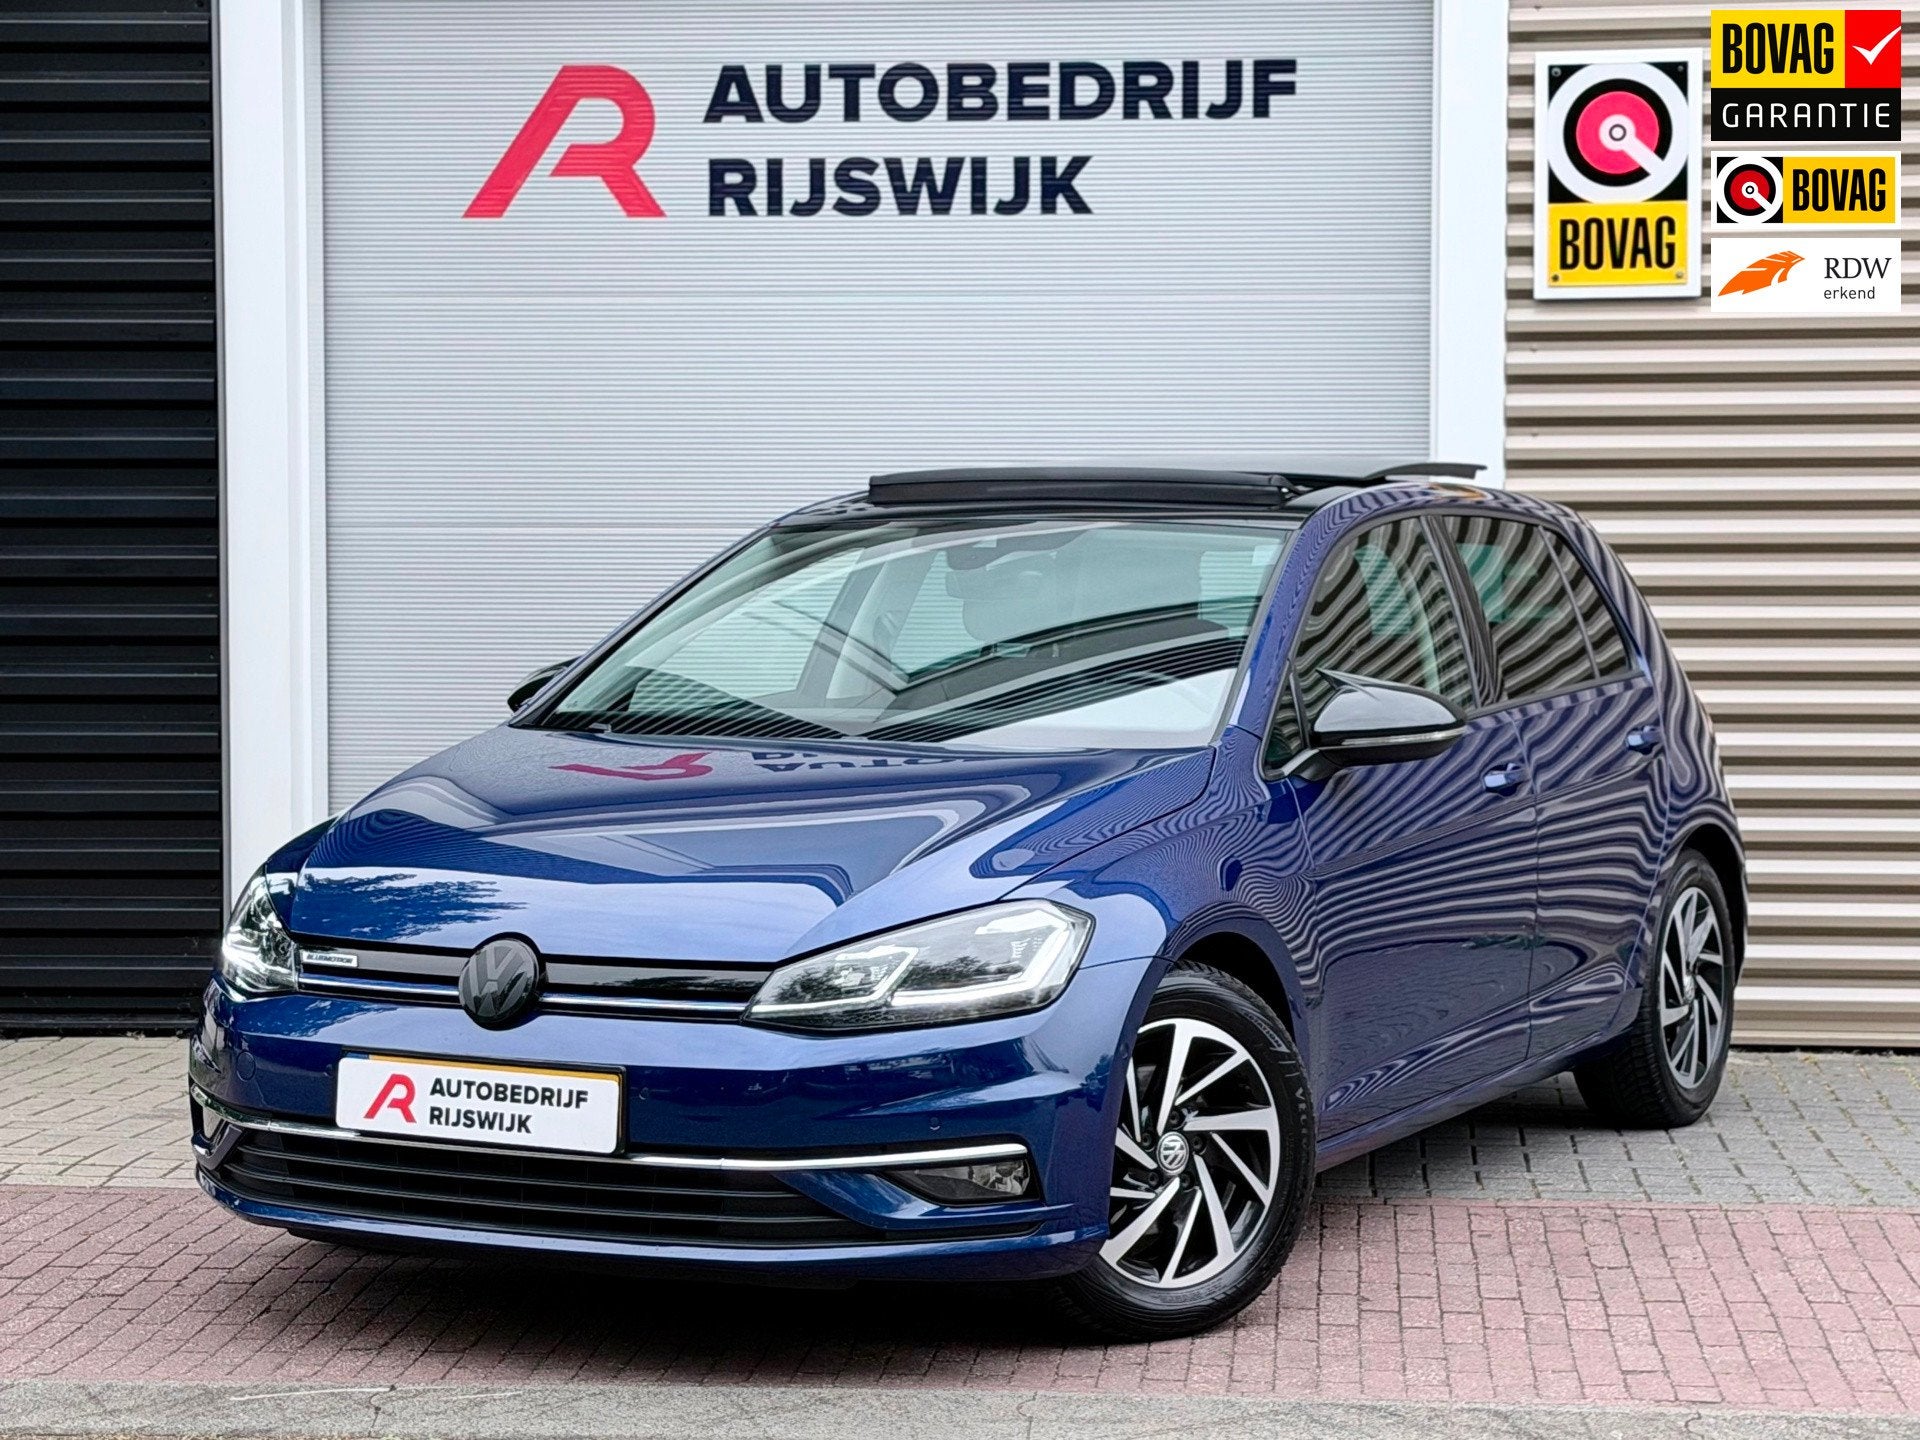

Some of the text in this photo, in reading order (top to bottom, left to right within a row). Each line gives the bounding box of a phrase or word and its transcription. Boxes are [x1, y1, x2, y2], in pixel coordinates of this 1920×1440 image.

[703, 59, 1297, 123] AUTOBEDRIJF
[709, 156, 1093, 217] RIJSWIJK
[1559, 216, 1676, 270] BOVAG
[429, 1077, 589, 1109] AUTOBEDRIJF
[429, 1107, 532, 1134] RIJSWIJK
